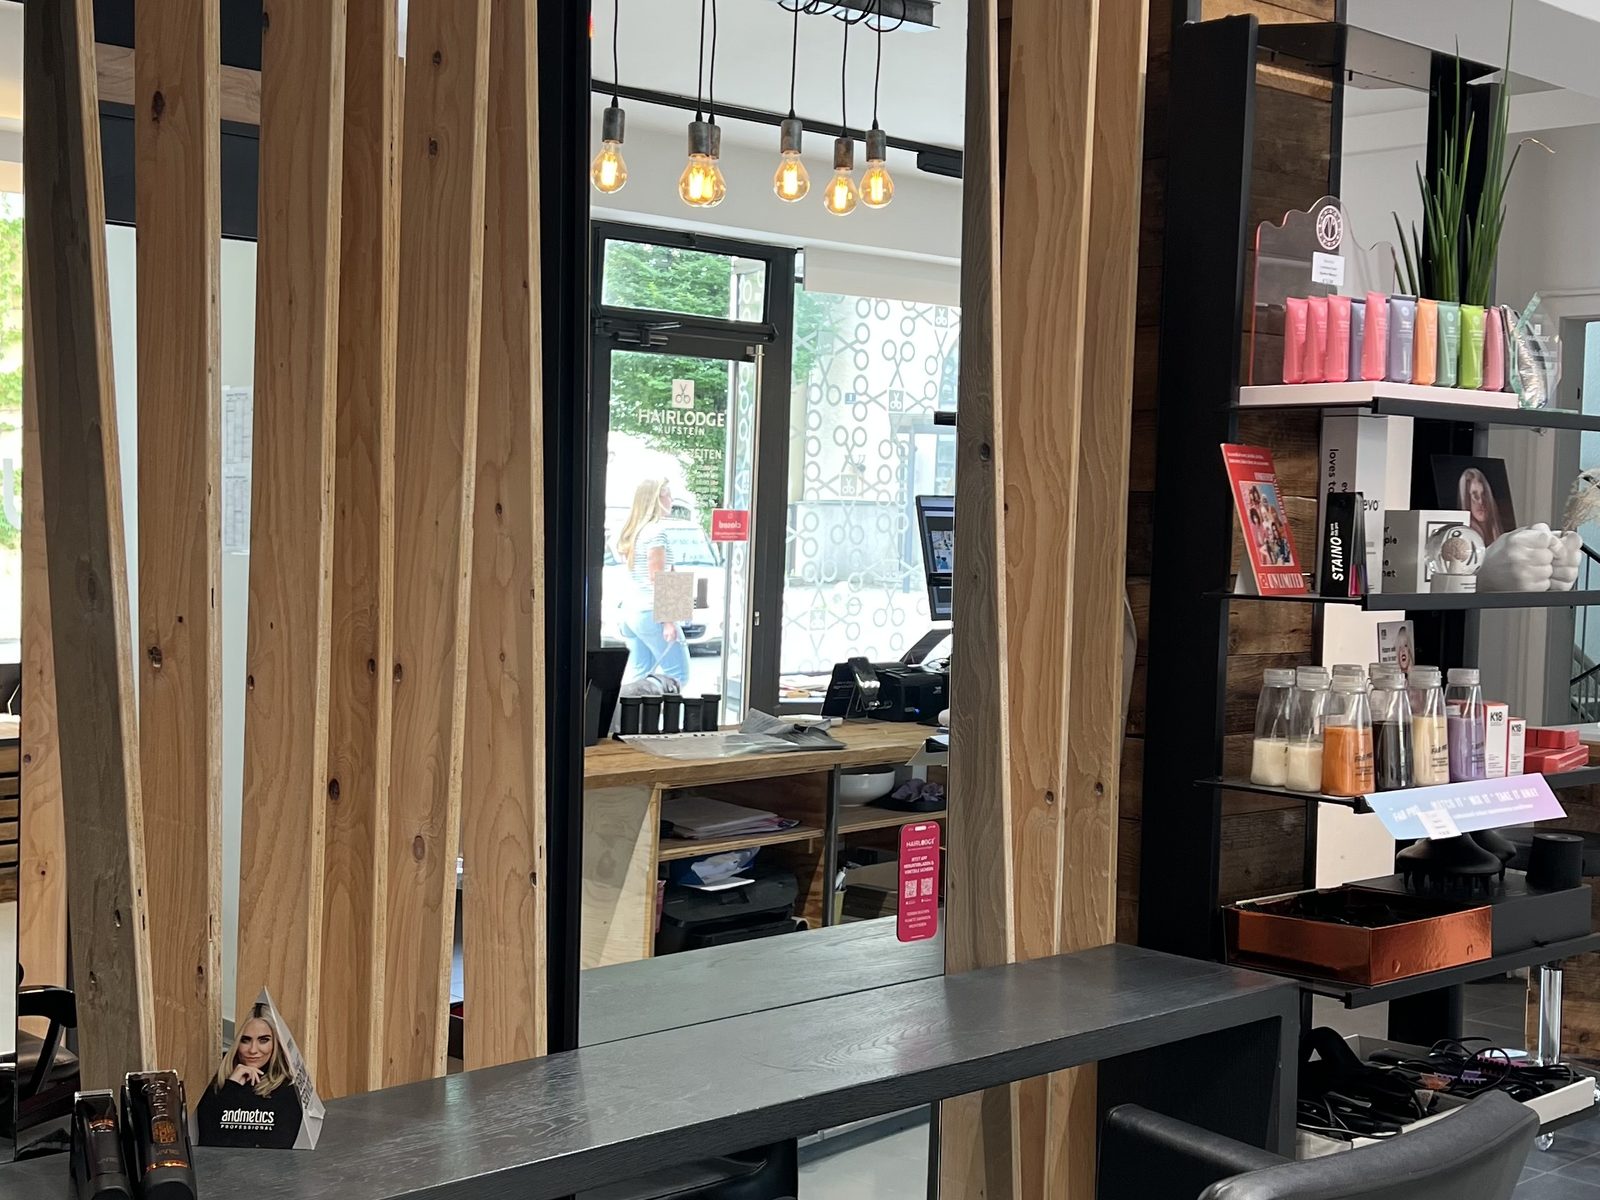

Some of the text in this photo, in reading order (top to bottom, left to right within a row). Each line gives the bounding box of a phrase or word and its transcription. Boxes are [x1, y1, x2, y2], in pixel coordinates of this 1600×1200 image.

[638, 409, 725, 427] HAIRLODGE
[658, 426, 705, 436] KUFSTEIN
[1328, 449, 1339, 478] loves
[1330, 537, 1344, 581] STAINO
[1490, 711, 1503, 721] K18
[221, 1108, 275, 1124] andmetics
